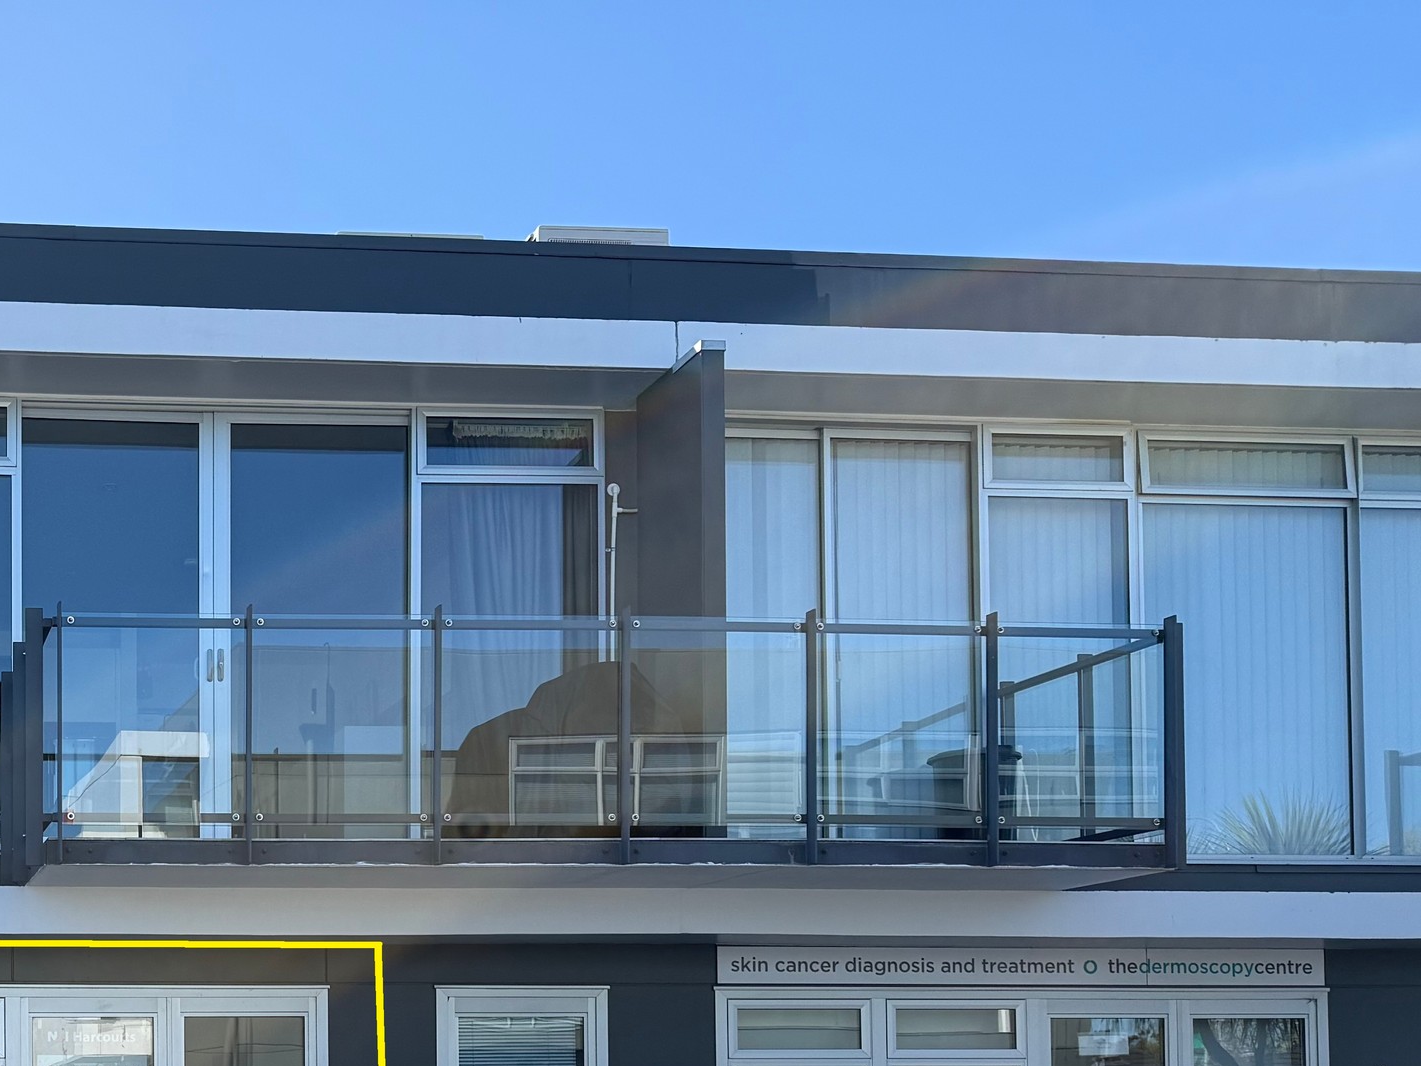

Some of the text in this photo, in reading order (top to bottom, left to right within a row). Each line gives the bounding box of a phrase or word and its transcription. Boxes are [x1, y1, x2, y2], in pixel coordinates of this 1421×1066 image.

[731, 957, 769, 973] skin
[775, 960, 839, 973] cancer
[845, 957, 935, 976] diagnosis
[941, 958, 975, 974] and
[981, 959, 1075, 974] treatment
[1108, 958, 1313, 977] thedermoscopycentre
[73, 1031, 136, 1043] Harcourts
